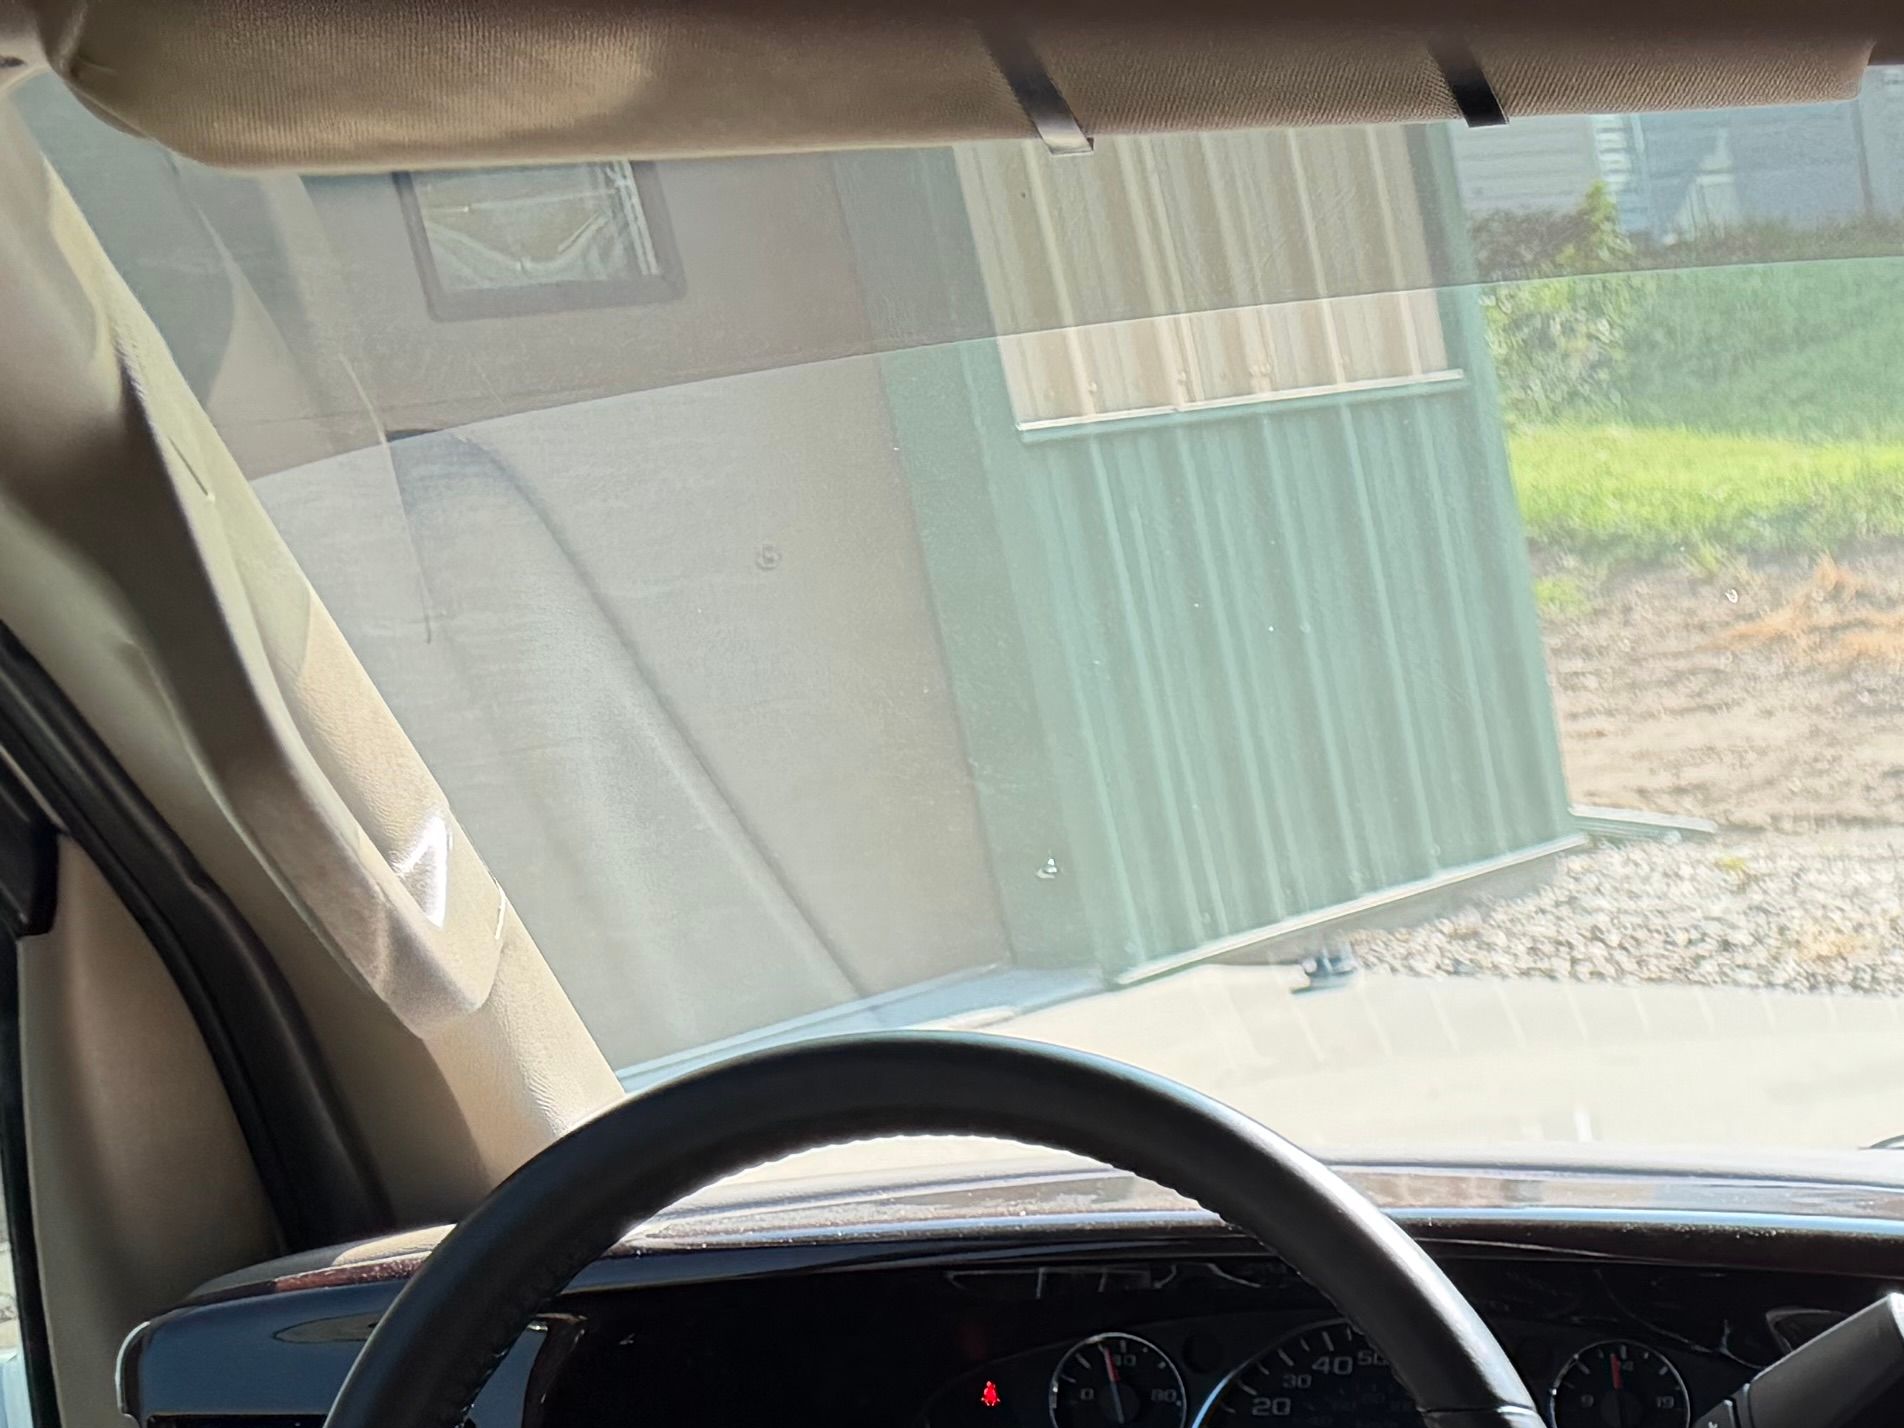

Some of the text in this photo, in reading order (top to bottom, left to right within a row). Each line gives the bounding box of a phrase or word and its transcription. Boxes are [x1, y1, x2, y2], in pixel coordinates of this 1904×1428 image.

[1312, 1355, 1353, 1376] 40
[1281, 1373, 1312, 1389] 30
[1251, 1397, 1292, 1416] 20
